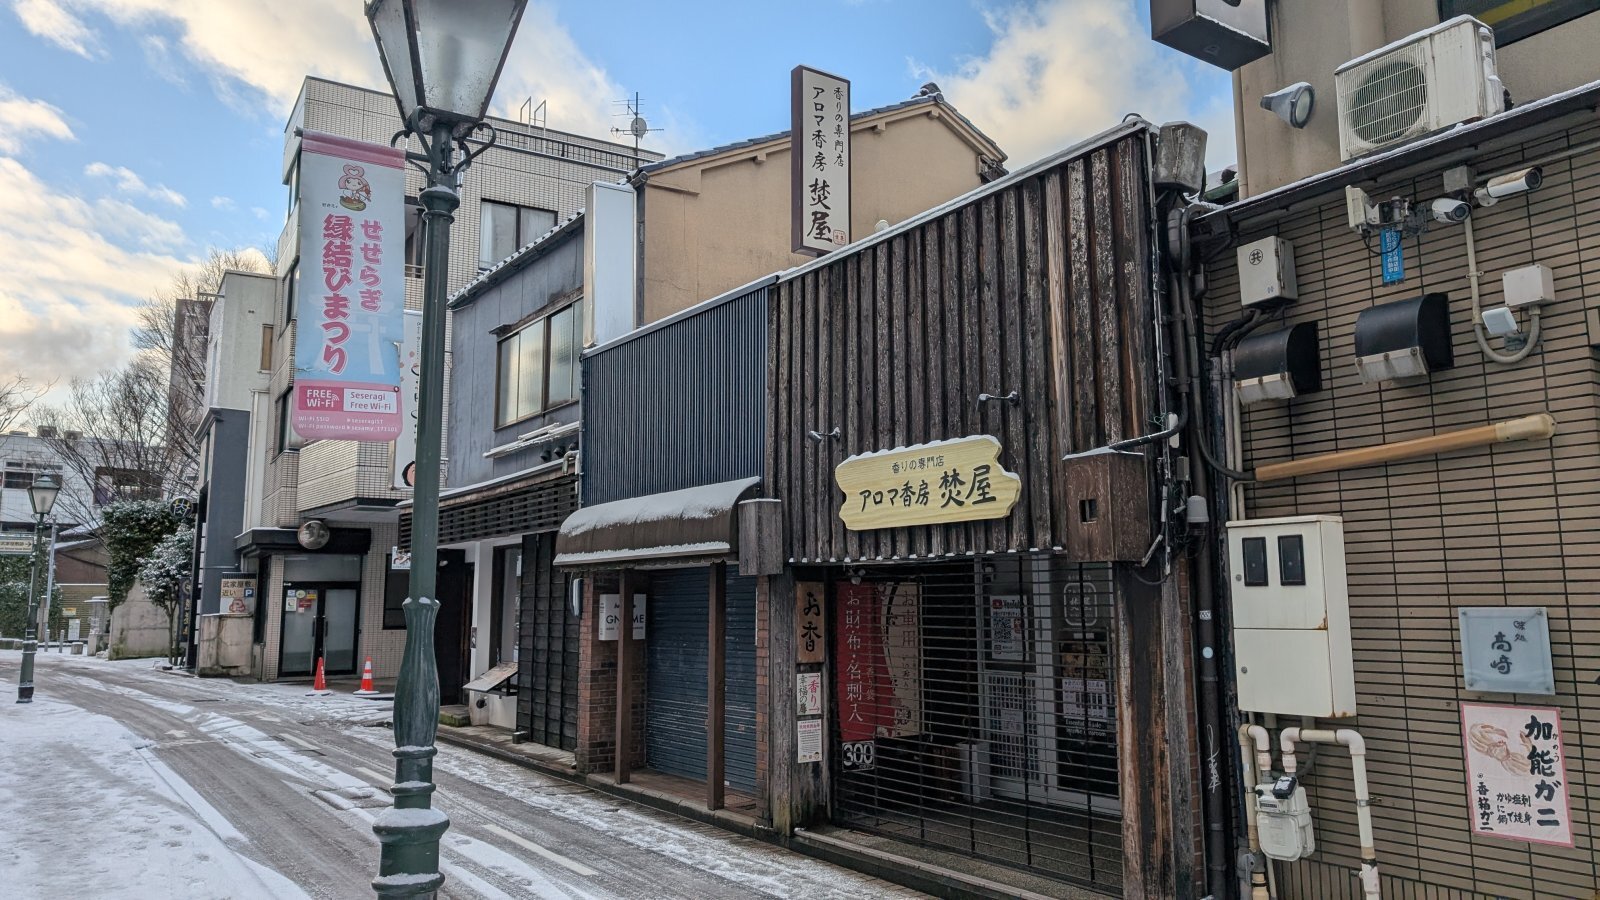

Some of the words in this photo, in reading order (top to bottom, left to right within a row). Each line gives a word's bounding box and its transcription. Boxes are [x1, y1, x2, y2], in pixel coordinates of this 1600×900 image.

[812, 86, 827, 172] アロマ香房
[807, 177, 833, 243] 焚屋
[360, 219, 383, 313] せせらぎ
[321, 213, 355, 376] 縁結びまつり
[306, 389, 332, 398] FREE
[306, 399, 334, 408] Wi-Fi
[350, 391, 386, 401] Seseragi
[350, 401, 369, 410] Free
[370, 402, 391, 411] Wi-Fi
[891, 455, 945, 474] 香りの専門店
[859, 480, 930, 512] アロマ香房
[938, 464, 997, 509] 焚屋
[245, 589, 253, 597] P
[606, 614, 645, 624] GNME
[801, 591, 823, 652] お香
[901, 590, 916, 648] お車用
[808, 680, 820, 708] 香り
[844, 743, 873, 767] 300
[1552, 733, 1560, 763] かのう
[1525, 714, 1562, 827] 加能ガニ
[1476, 782, 1494, 832] 香箱ガニ
[1521, 794, 1532, 826] 刺身
